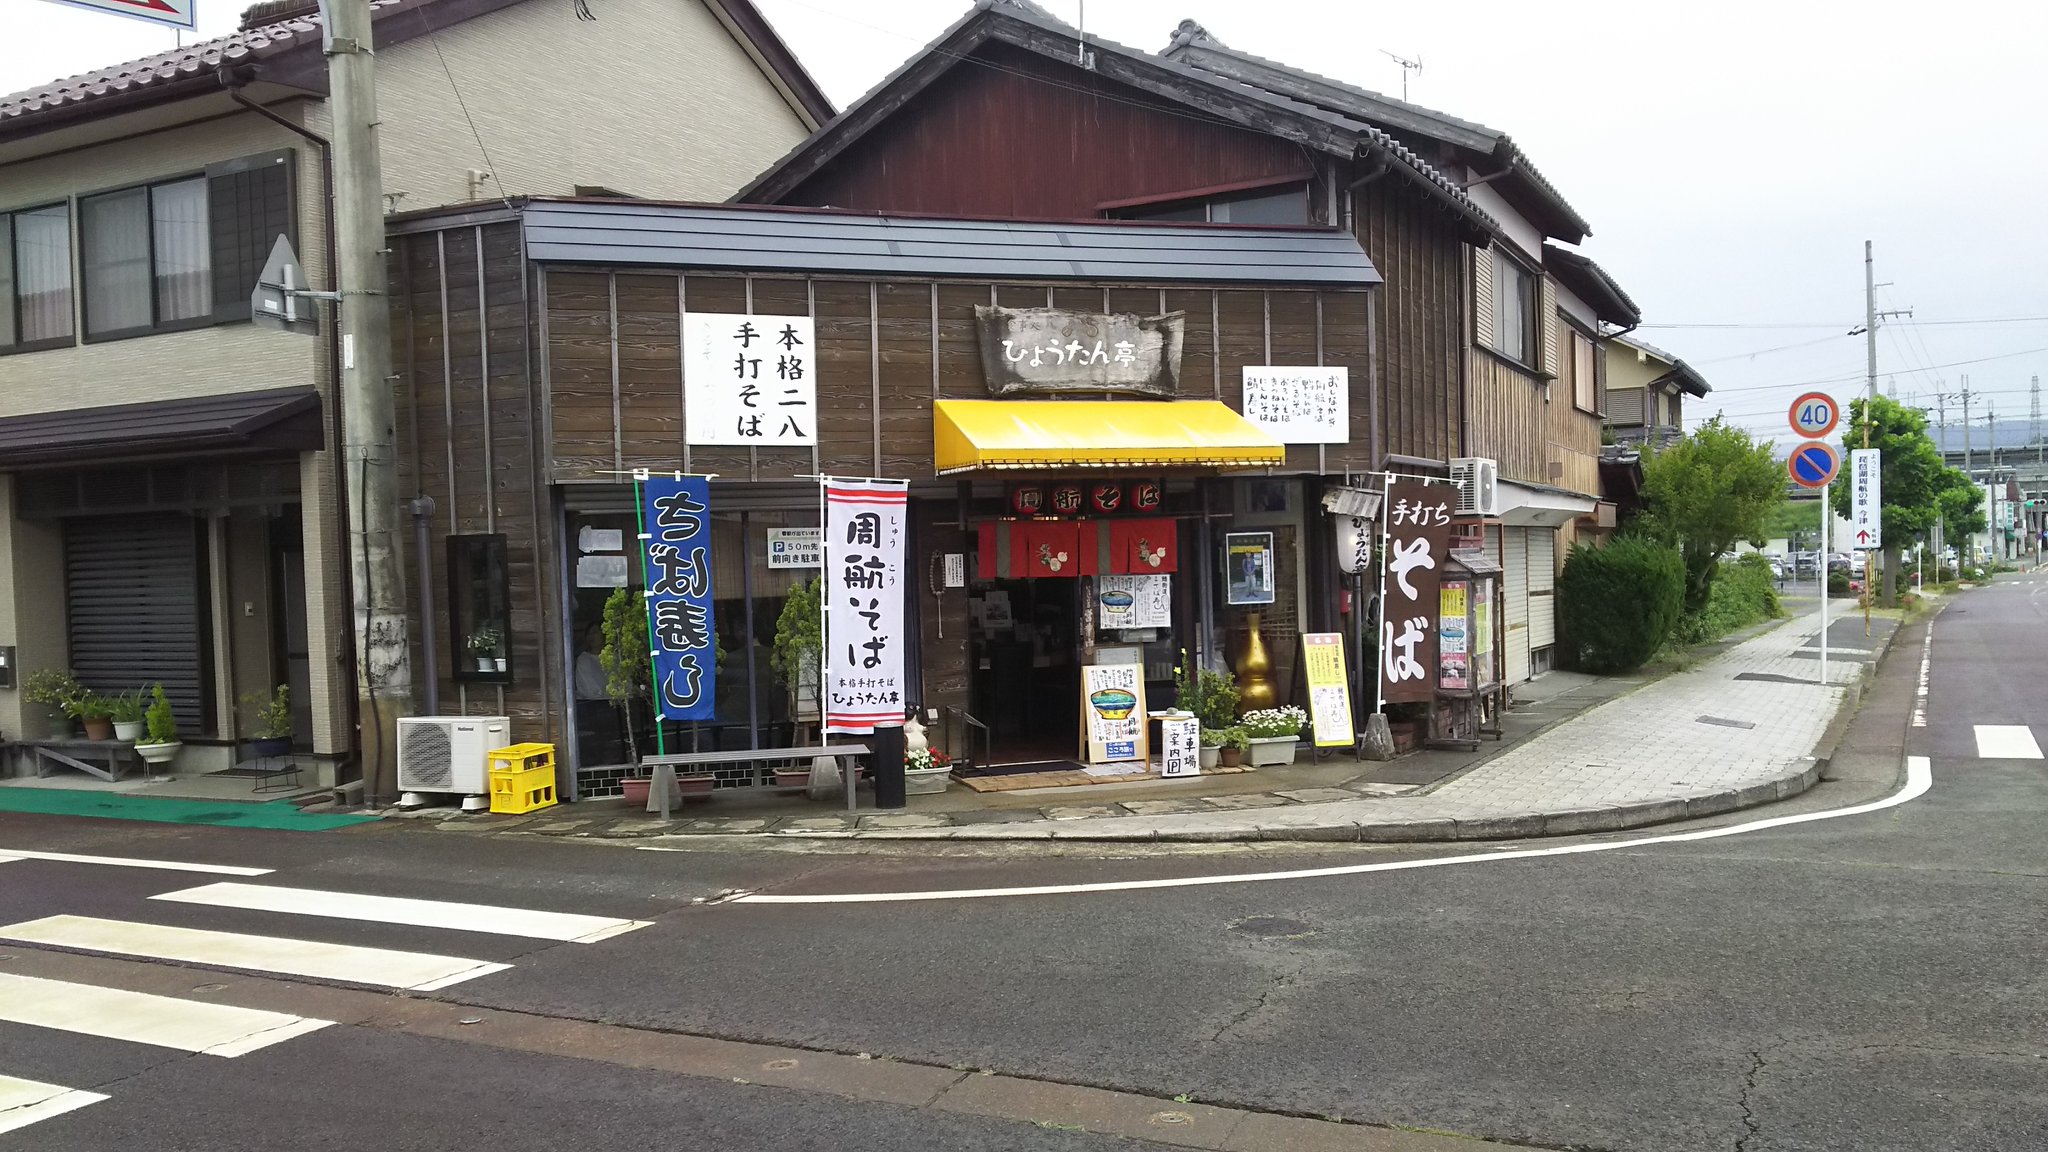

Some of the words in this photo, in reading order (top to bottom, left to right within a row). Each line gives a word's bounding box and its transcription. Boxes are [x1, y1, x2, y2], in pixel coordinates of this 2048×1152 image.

[1002, 338, 1136, 368] ひょうたん亭
[733, 321, 765, 438] 手打そば
[776, 323, 807, 438] 本格二八
[1800, 404, 1828, 426] 40
[1858, 456, 1868, 506] 琵琶湖周航の歌
[1392, 498, 1450, 527] 手打ち
[1858, 509, 1868, 524] 今津
[772, 553, 820, 564] 前向き駐車
[843, 512, 888, 669] 周航そば
[1385, 536, 1436, 684] そば
[838, 677, 896, 688] 本格手打そば
[832, 690, 900, 707] ひょうたん亭
[1183, 722, 1197, 768] 駐車場
